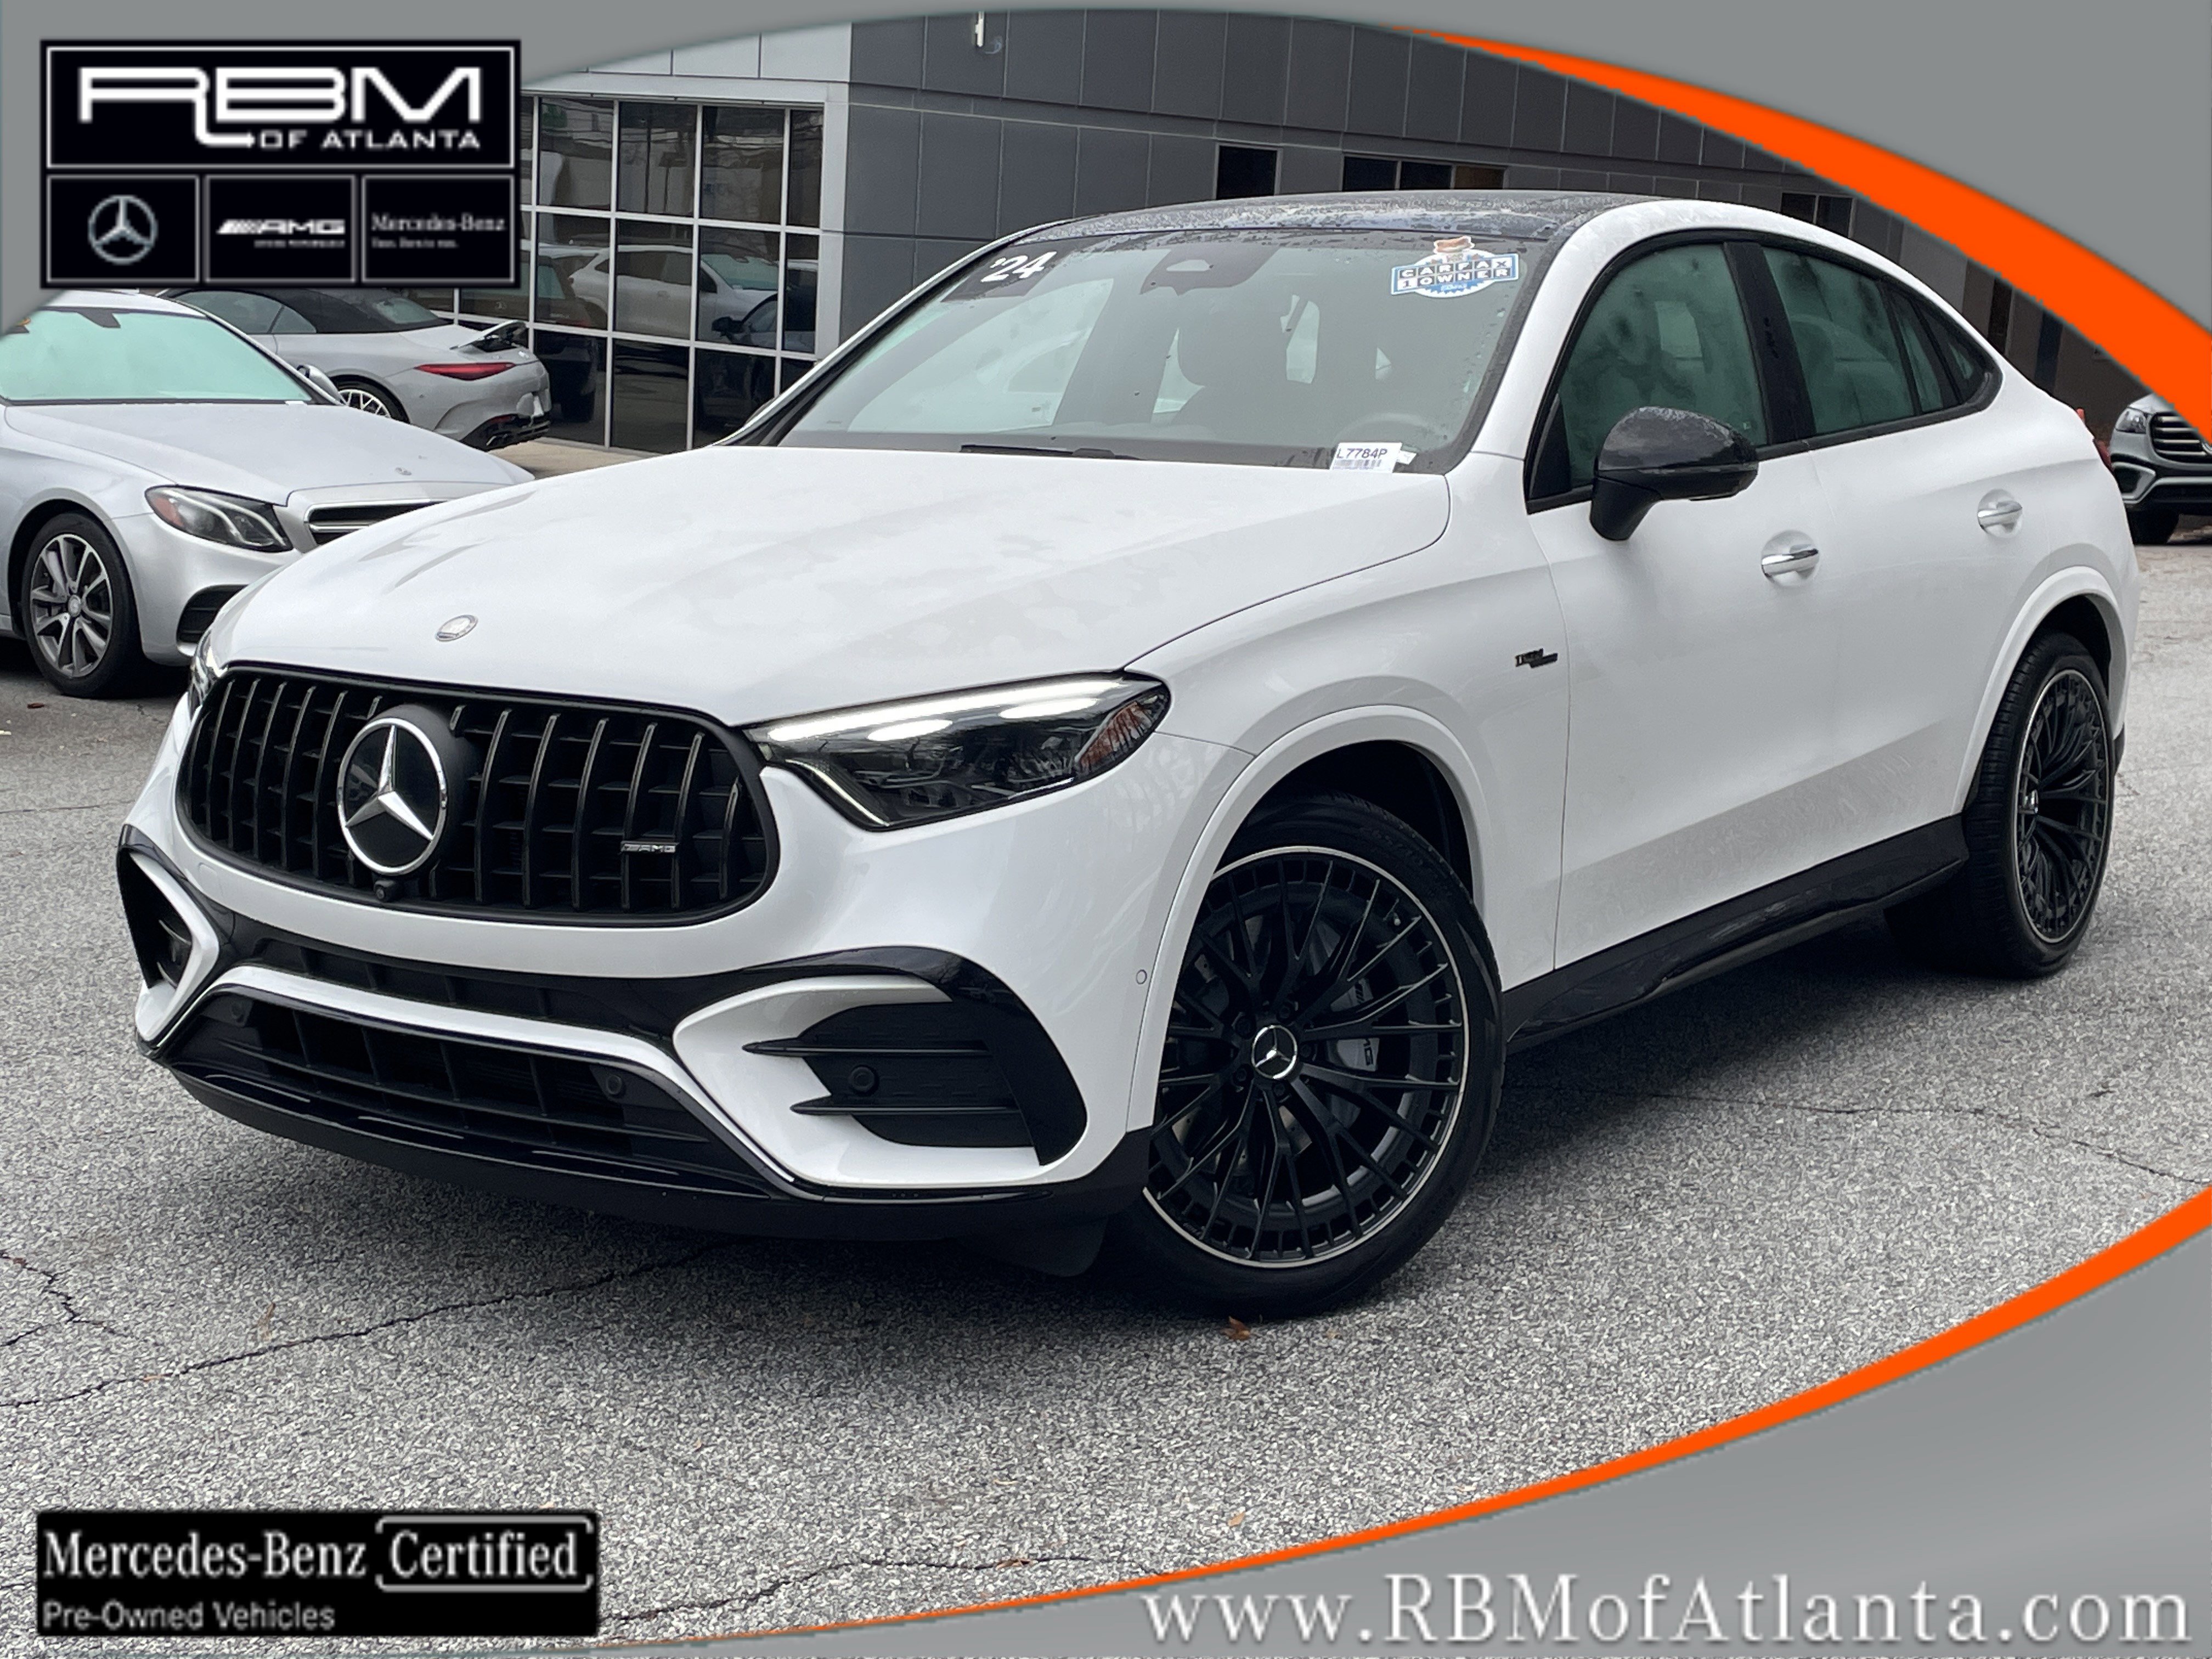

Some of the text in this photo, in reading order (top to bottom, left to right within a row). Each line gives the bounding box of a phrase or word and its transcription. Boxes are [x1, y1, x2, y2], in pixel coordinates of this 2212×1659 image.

[1401, 259, 1508, 278] CARFAX
[1420, 268, 1508, 285] OWNER
[1336, 448, 1388, 459] L7784P
[638, 844, 675, 853] AMG
